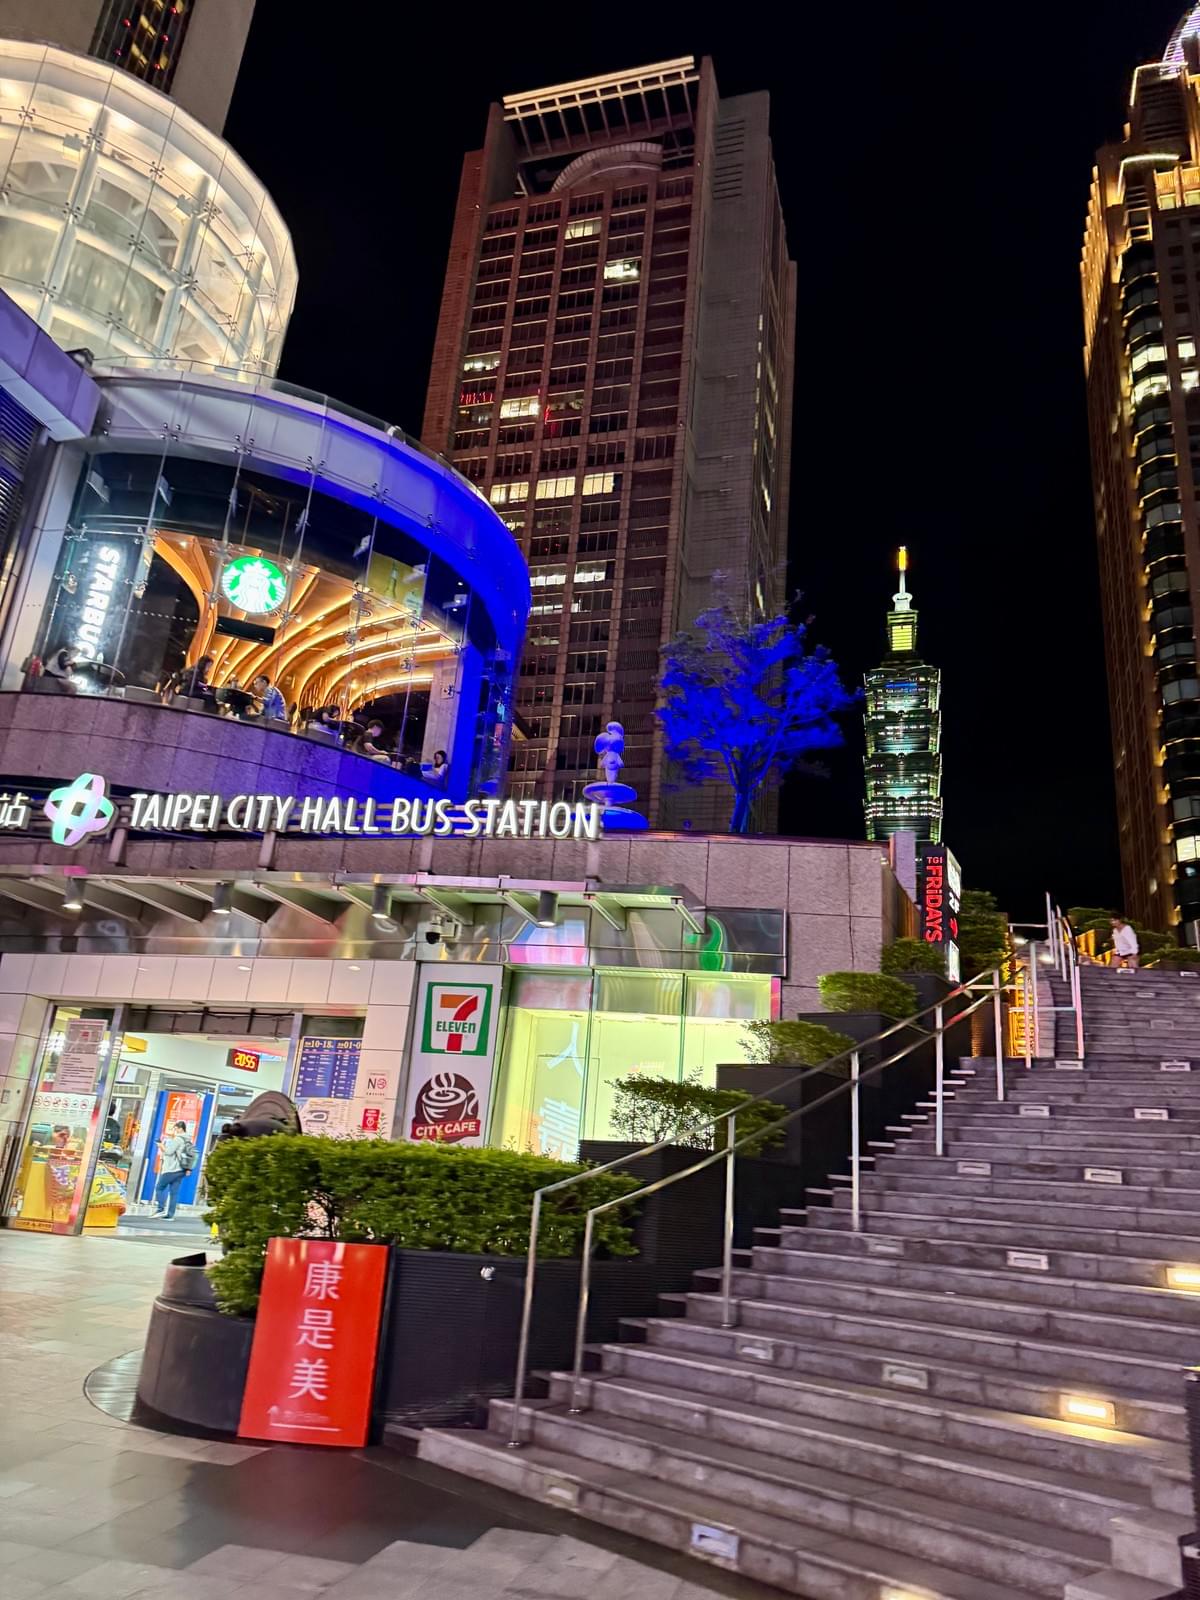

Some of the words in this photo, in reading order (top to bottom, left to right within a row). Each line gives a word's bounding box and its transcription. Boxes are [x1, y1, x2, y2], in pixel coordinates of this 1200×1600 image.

[130, 793, 219, 829] TAIPEI
[227, 795, 293, 829] CITY
[300, 796, 379, 832] HALL
[391, 798, 451, 834] BUS
[464, 799, 598, 839] STATION
[926, 856, 943, 864] TGI
[415, 1124, 445, 1137] CITY
[444, 1121, 477, 1133] CAFE
[287, 1260, 344, 1402] 康是美
